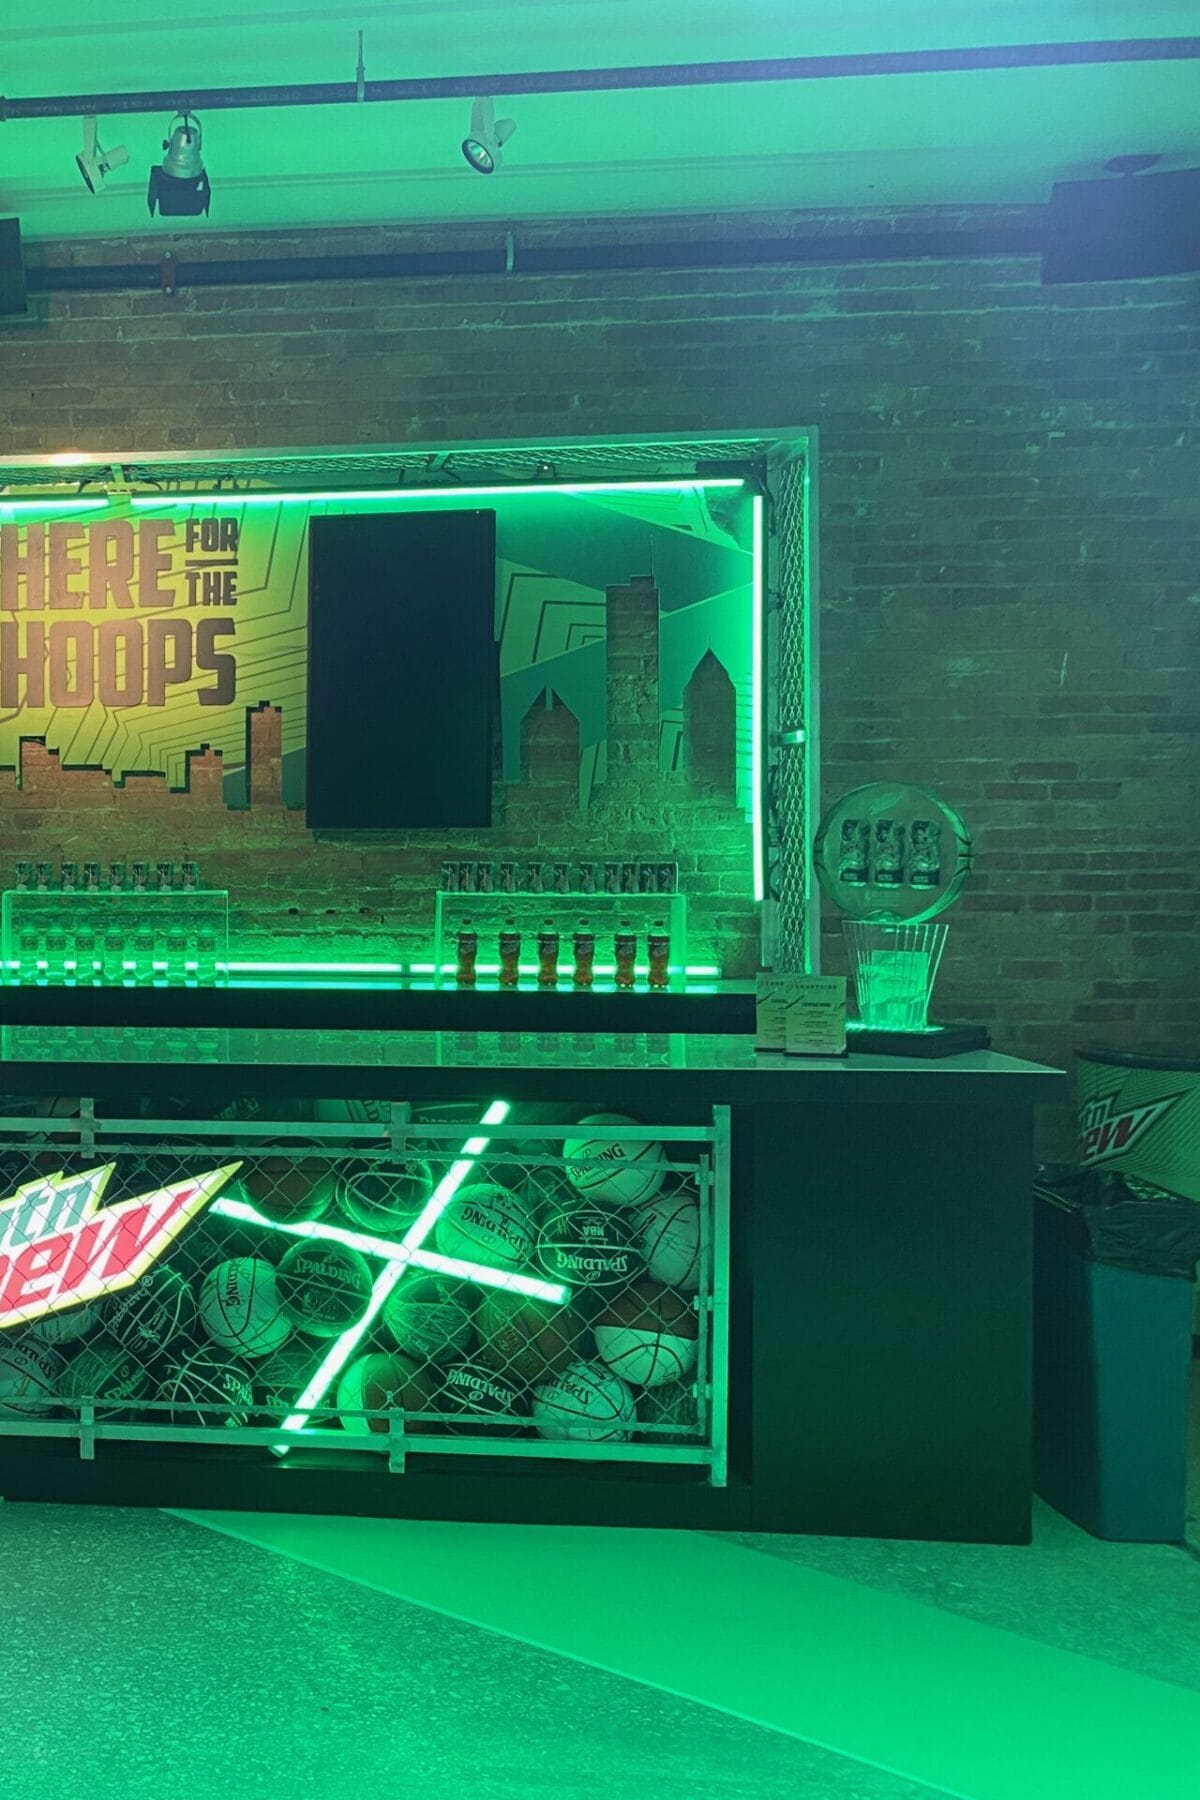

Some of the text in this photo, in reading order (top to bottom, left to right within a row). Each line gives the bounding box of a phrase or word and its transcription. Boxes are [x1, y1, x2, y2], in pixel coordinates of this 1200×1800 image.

[0, 517, 239, 611] HERE FOR
[185, 571, 238, 607] THE
[0, 618, 236, 708] HOOPS
[582, 1225, 605, 1237] NBA
[293, 1258, 361, 1290] SPALDING
[557, 1252, 628, 1272] SPALDING
[448, 1369, 515, 1408] SPALDING
